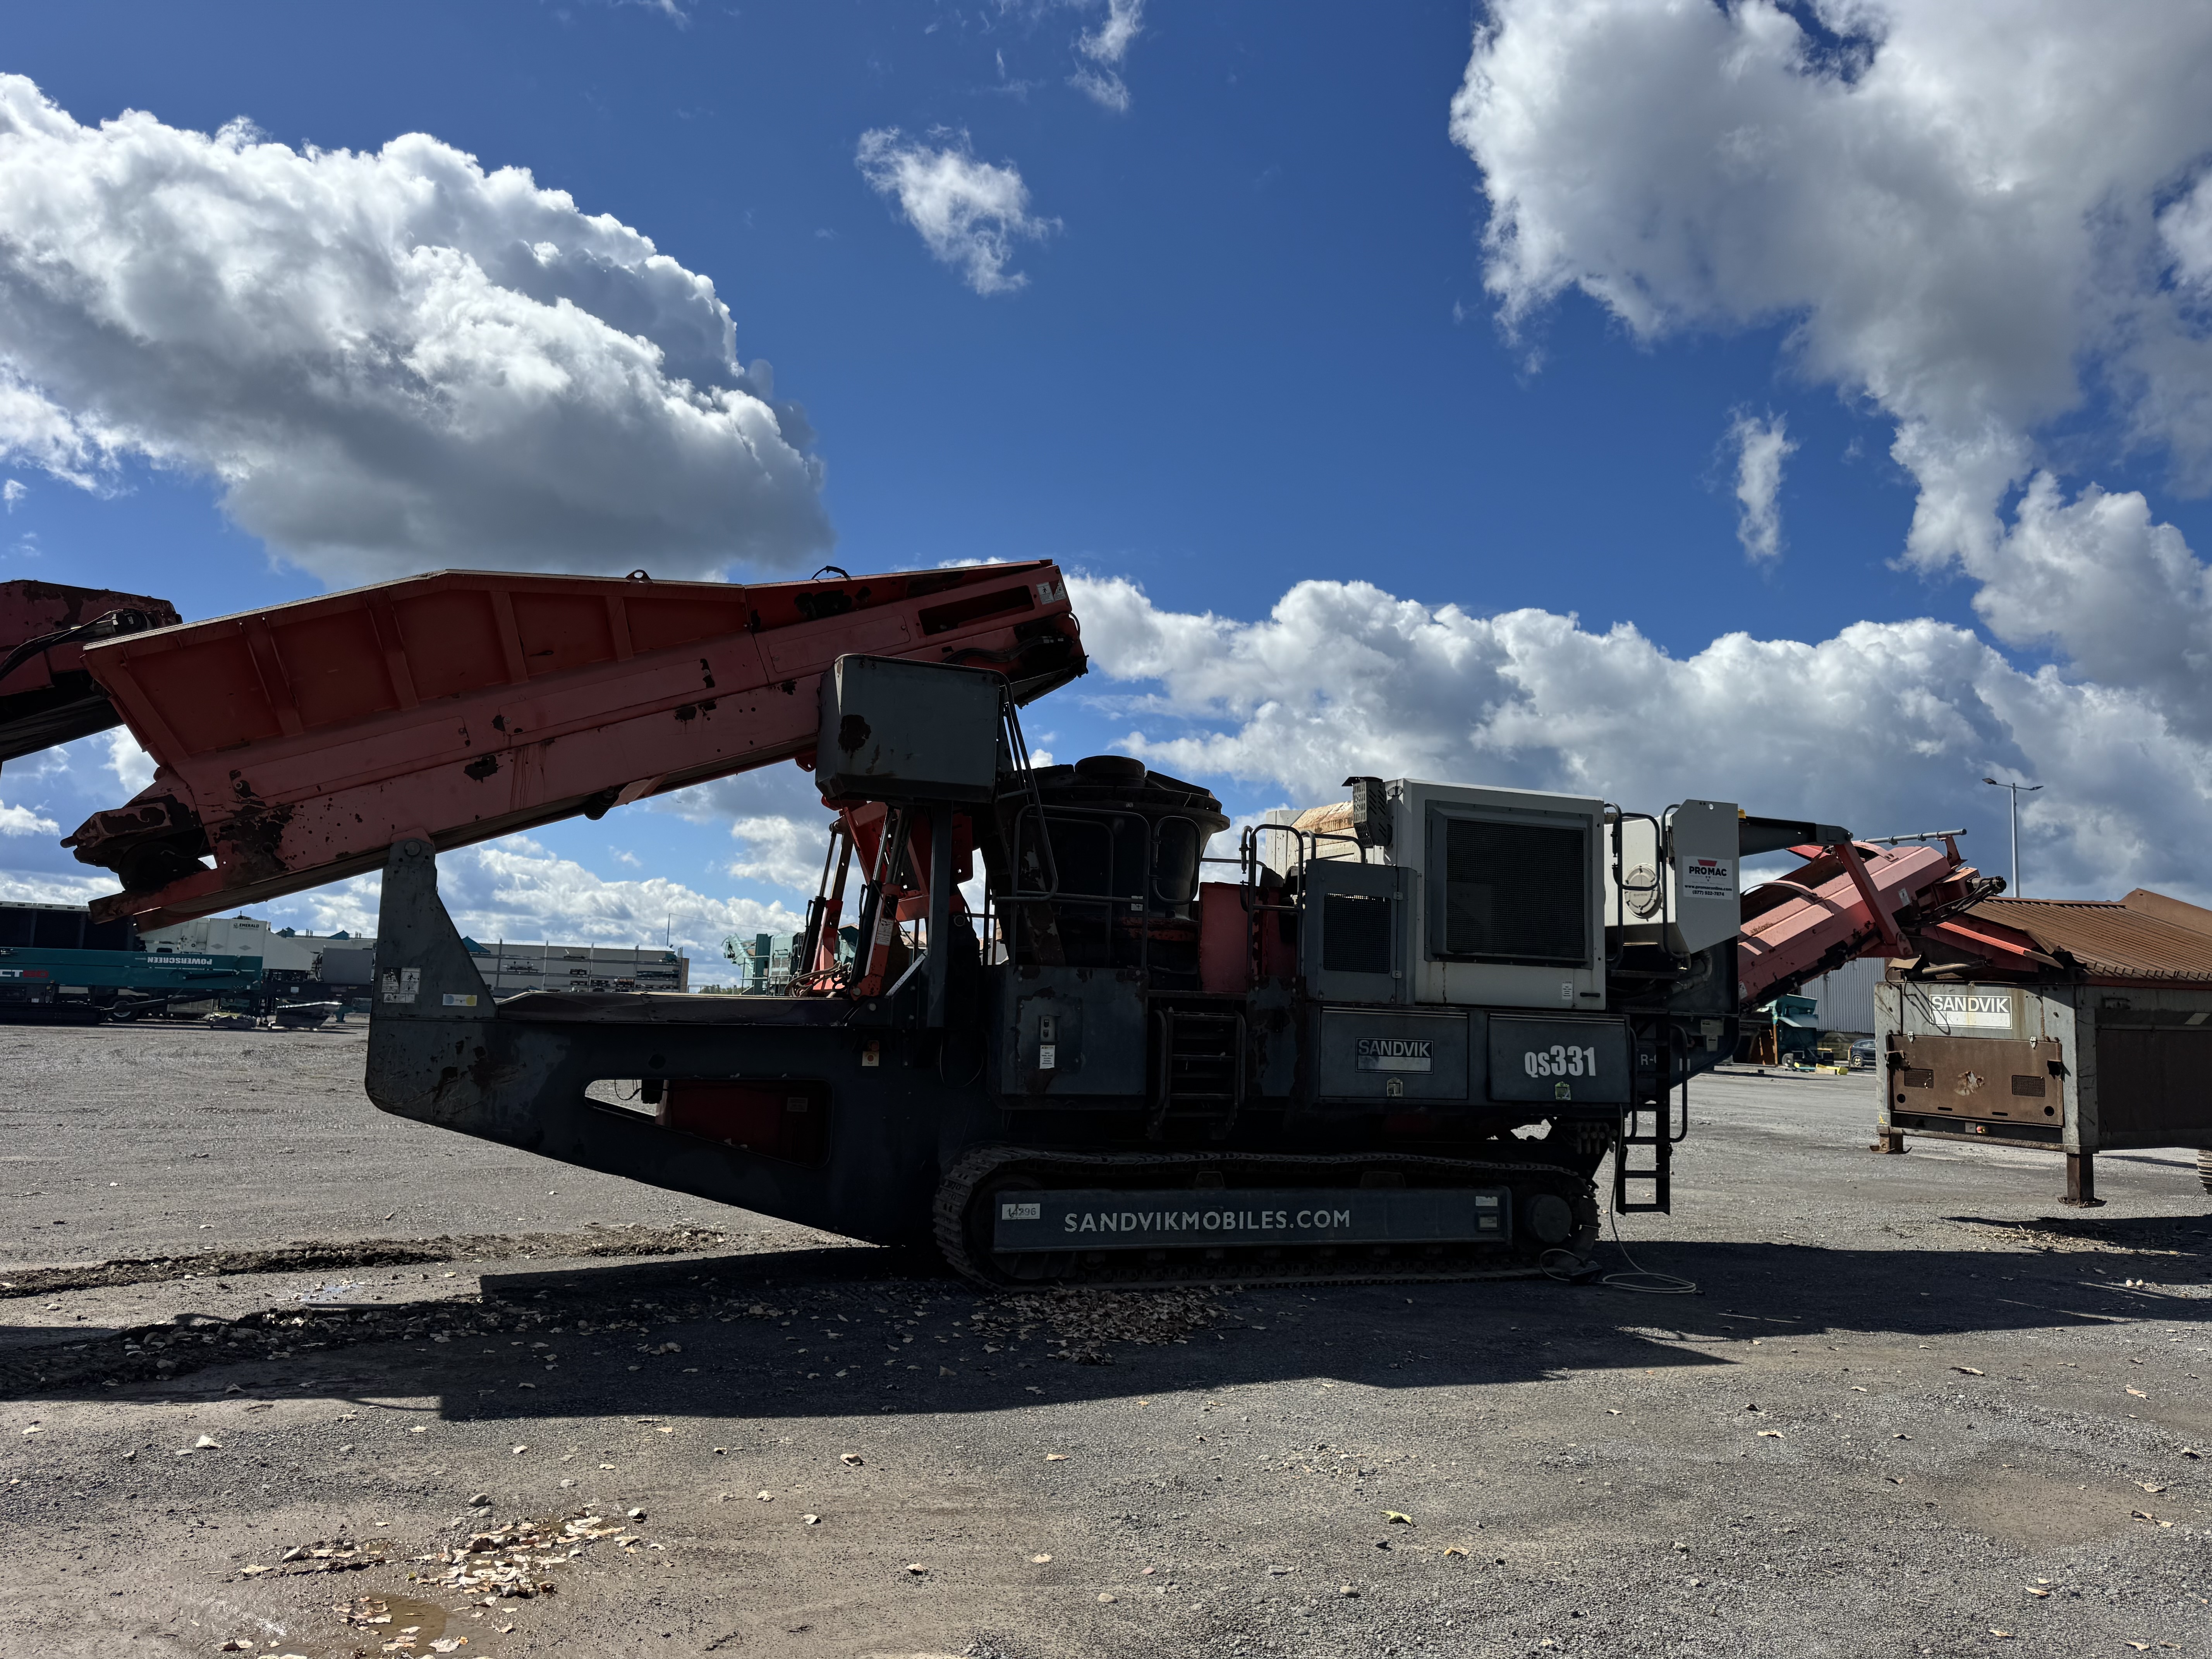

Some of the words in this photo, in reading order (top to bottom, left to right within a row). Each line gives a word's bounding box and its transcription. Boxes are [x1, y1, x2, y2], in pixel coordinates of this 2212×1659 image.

[1689, 866, 1727, 876] PROMAC
[147, 957, 213, 965] POWERSCREEN
[1931, 996, 2009, 1013] SANDVIK
[1358, 1039, 1431, 1057] SANDVIK
[1524, 1045, 1596, 1078] QS331
[1064, 1209, 1350, 1233] SANDVIKMOBILES.COM
